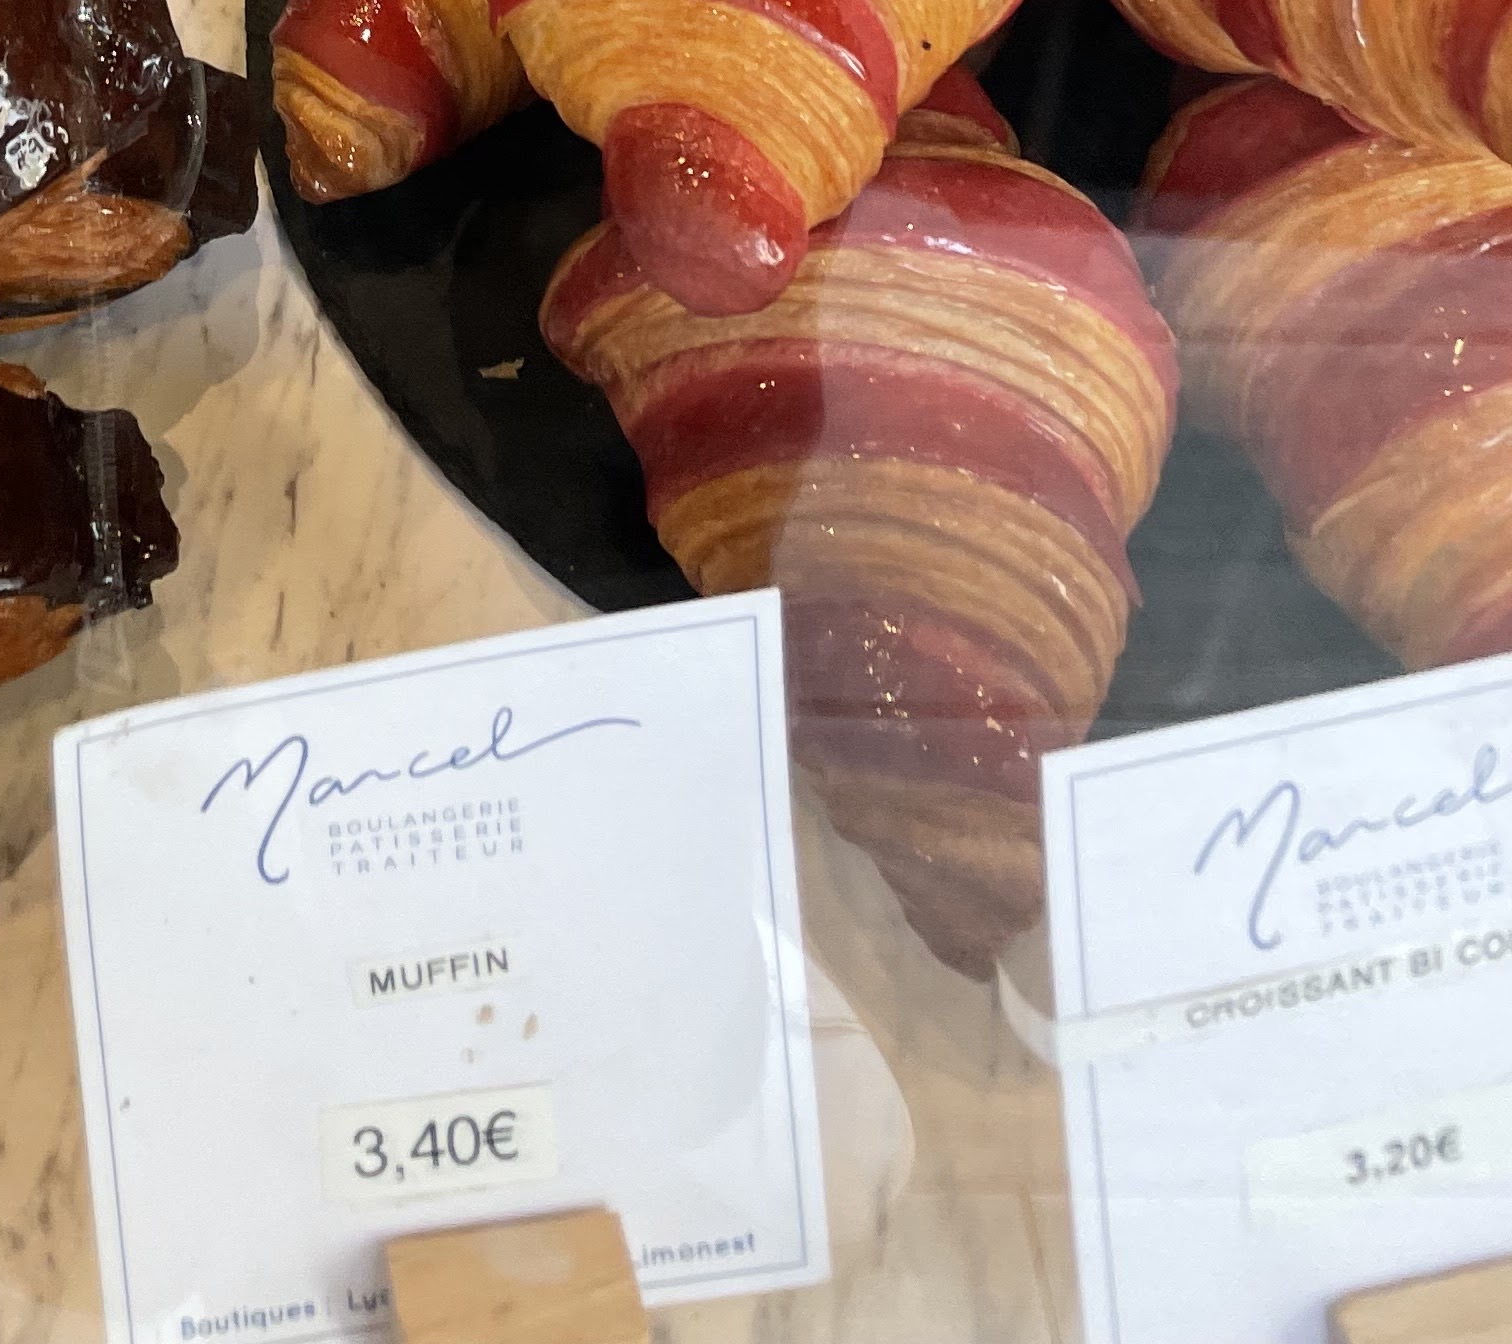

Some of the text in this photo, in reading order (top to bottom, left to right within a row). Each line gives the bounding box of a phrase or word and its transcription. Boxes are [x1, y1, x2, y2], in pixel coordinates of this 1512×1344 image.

[199, 706, 643, 885] Marcel
[328, 796, 519, 839] BOULANGERIE
[334, 836, 523, 877] TRAITEUR
[1192, 742, 1512, 951] Marcel
[368, 947, 510, 997] MUFFIN
[1185, 928, 1512, 1029] CROISSANT BI CO
[352, 1108, 520, 1183] 3,40€
[180, 1297, 316, 1342] Boutiques
[636, 1230, 756, 1269] imonest
